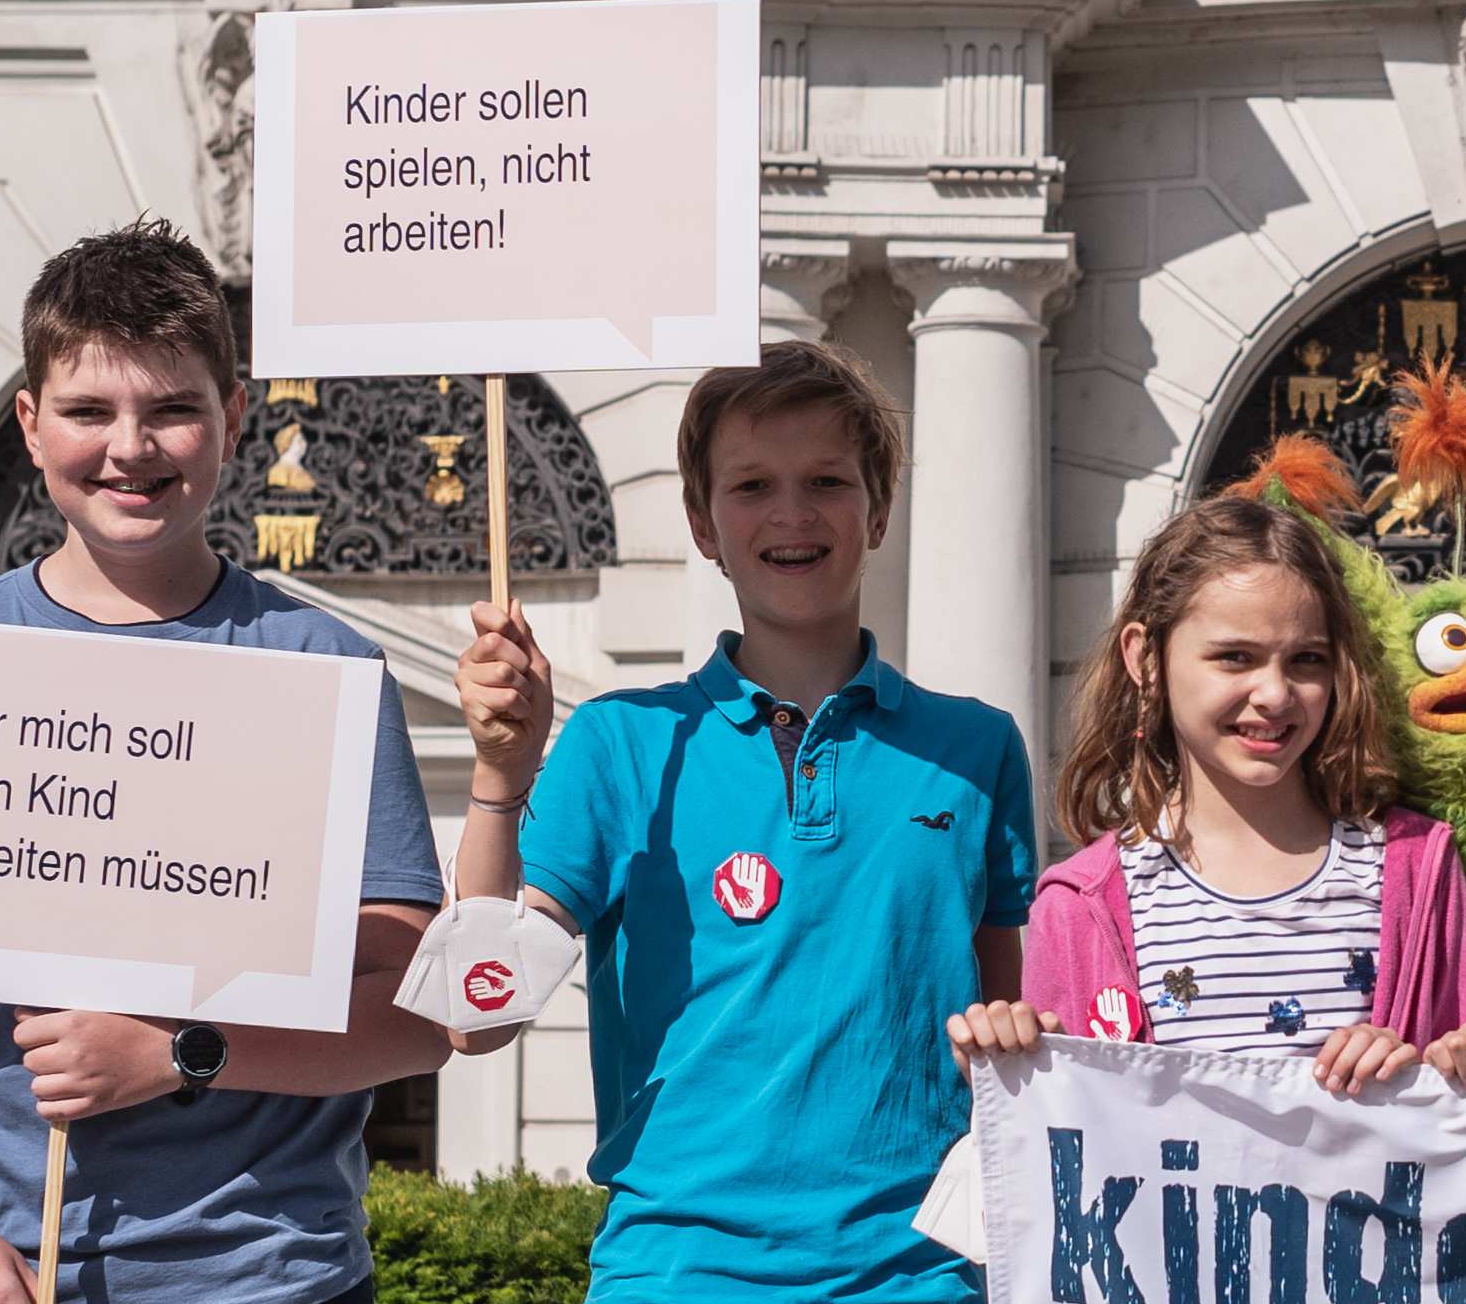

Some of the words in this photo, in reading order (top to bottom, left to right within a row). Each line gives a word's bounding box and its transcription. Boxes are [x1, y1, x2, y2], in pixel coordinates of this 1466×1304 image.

[346, 82, 467, 126] Kinder
[478, 79, 587, 122] sollen
[343, 146, 486, 200] spielen,
[502, 142, 591, 185] nicht
[343, 208, 505, 254] arbeiten!
[18, 709, 112, 754] mich
[126, 720, 195, 762] soll
[27, 772, 118, 821] Kind
[101, 849, 271, 901] müssen!
